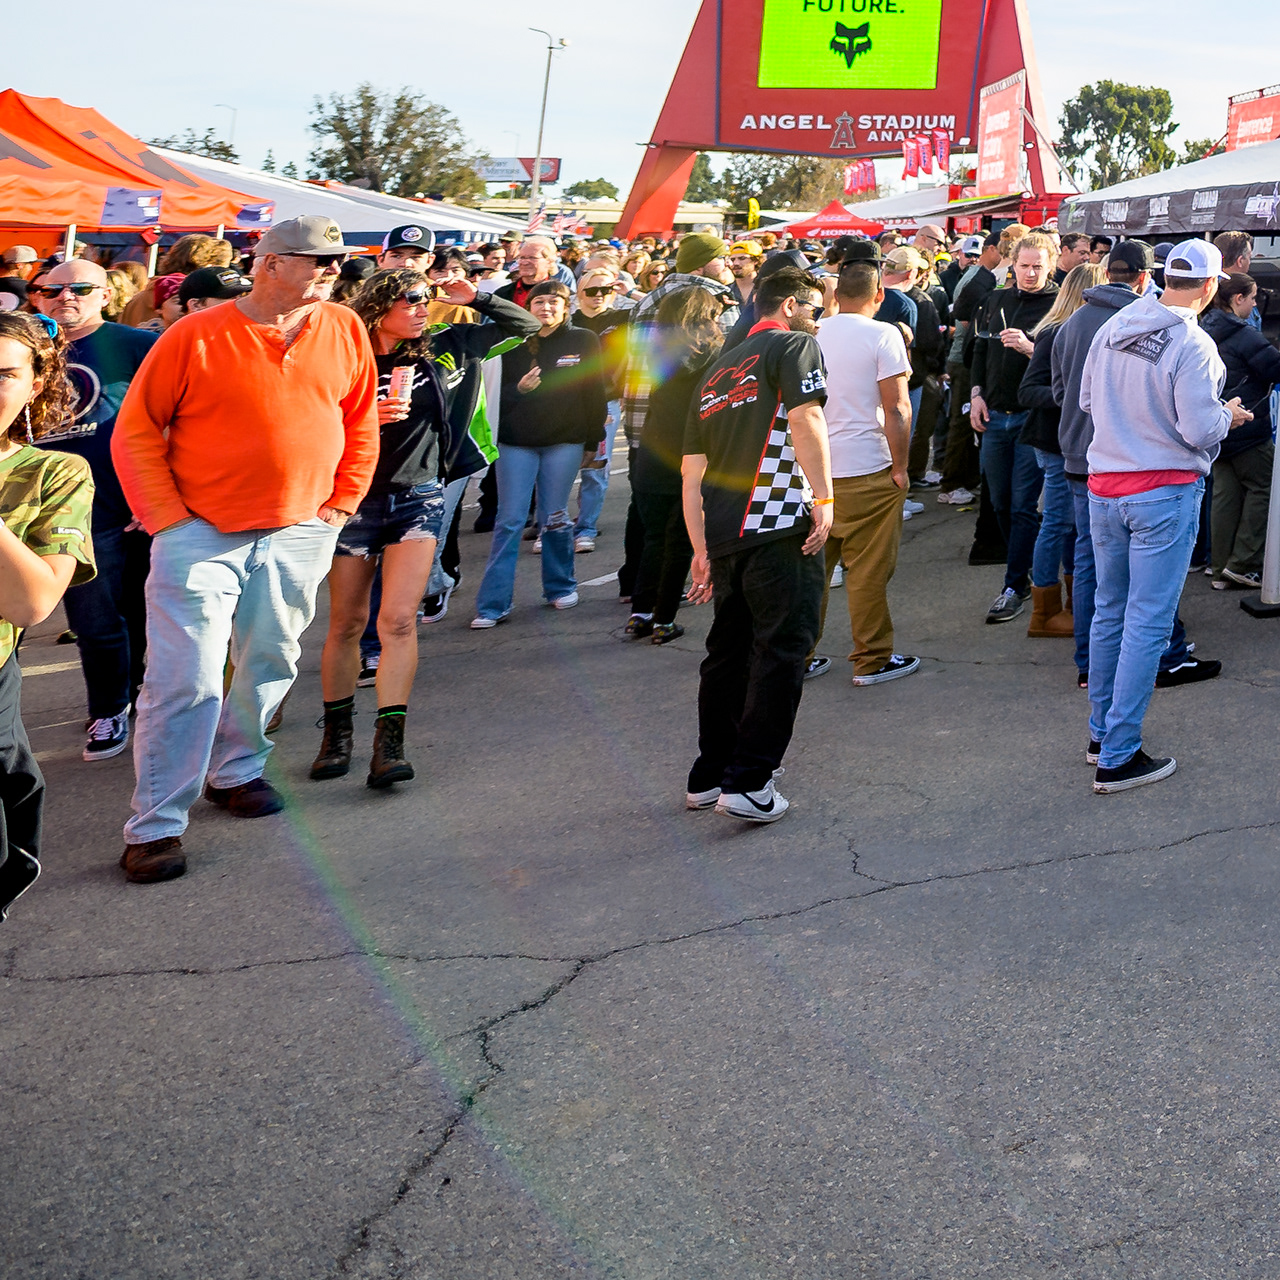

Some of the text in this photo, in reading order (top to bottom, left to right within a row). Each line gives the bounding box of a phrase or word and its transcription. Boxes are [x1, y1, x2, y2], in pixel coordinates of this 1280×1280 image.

[739, 114, 832, 130] ANGEL
[857, 114, 956, 130] STADIUM
[866, 130, 955, 142] ANAH
[820, 228, 864, 237] HONDA
